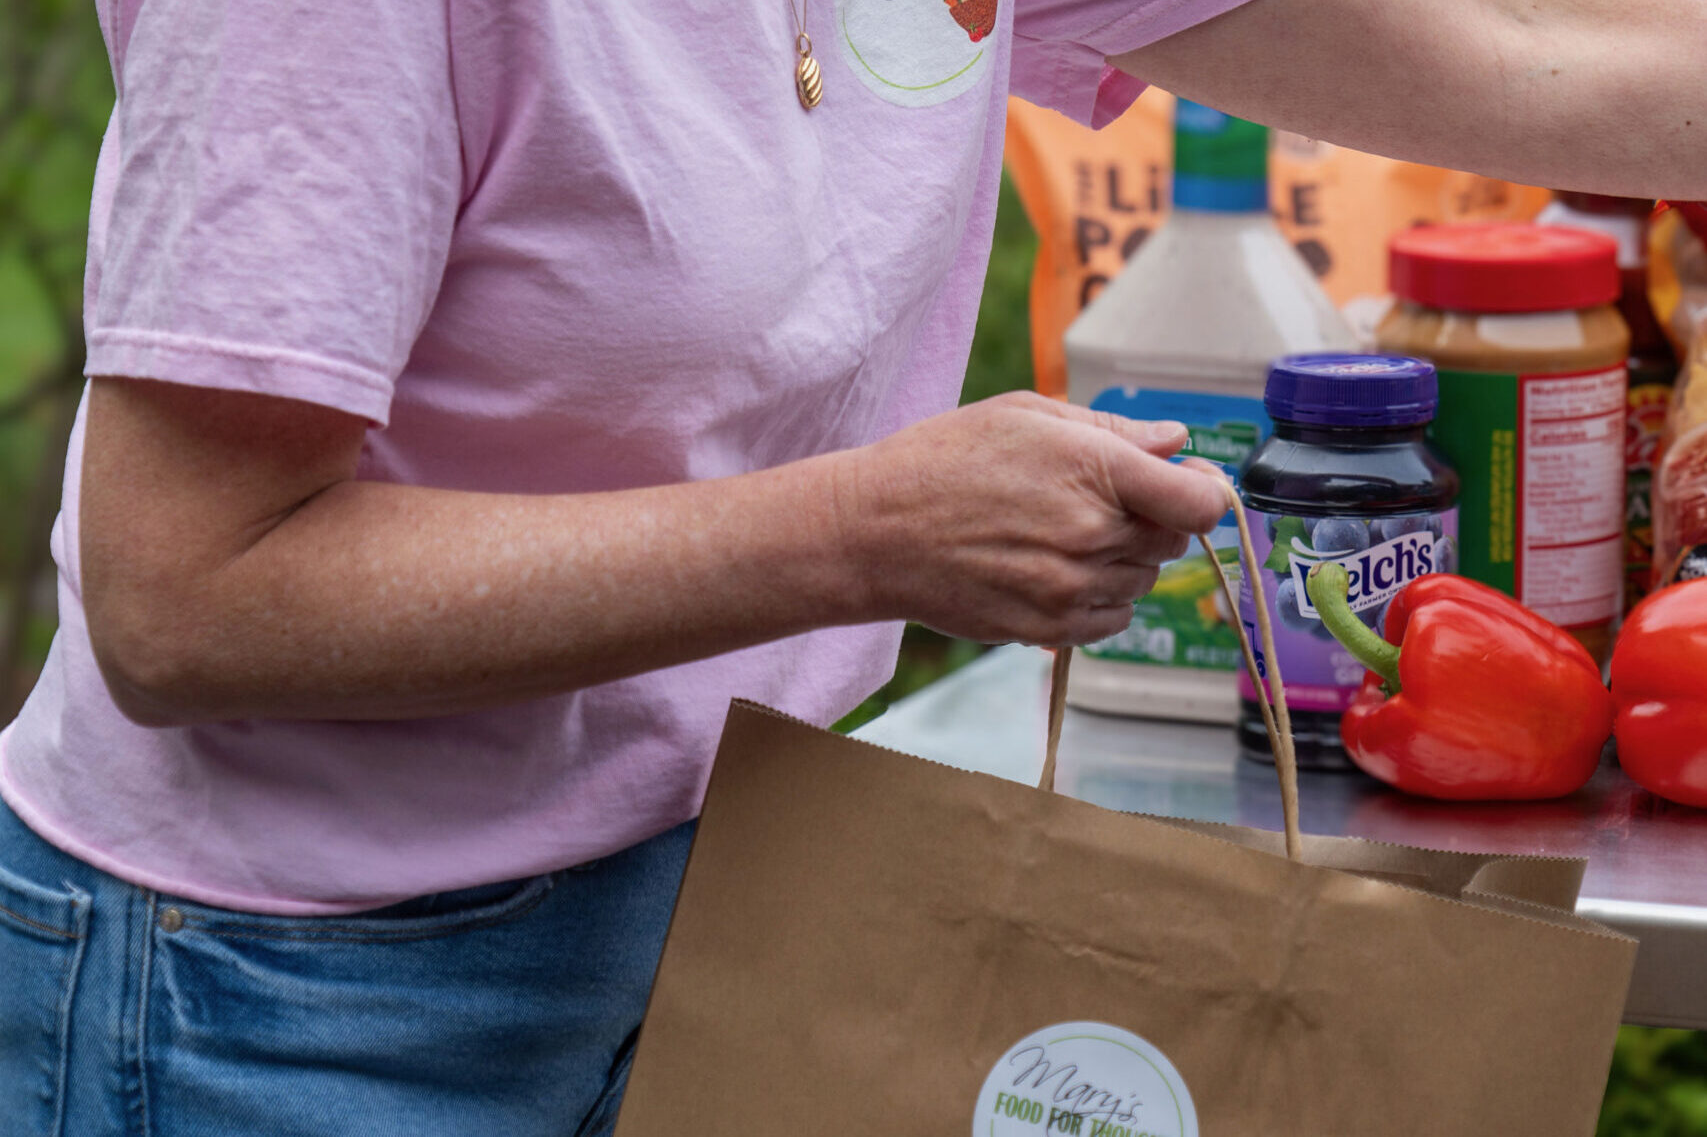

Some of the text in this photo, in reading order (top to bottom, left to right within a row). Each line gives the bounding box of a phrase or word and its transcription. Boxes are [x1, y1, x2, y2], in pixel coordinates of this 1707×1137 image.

[994, 1092, 1043, 1125] FOOD
[1050, 1107, 1083, 1136] FOR
[1009, 1046, 1143, 1137] Mary's
